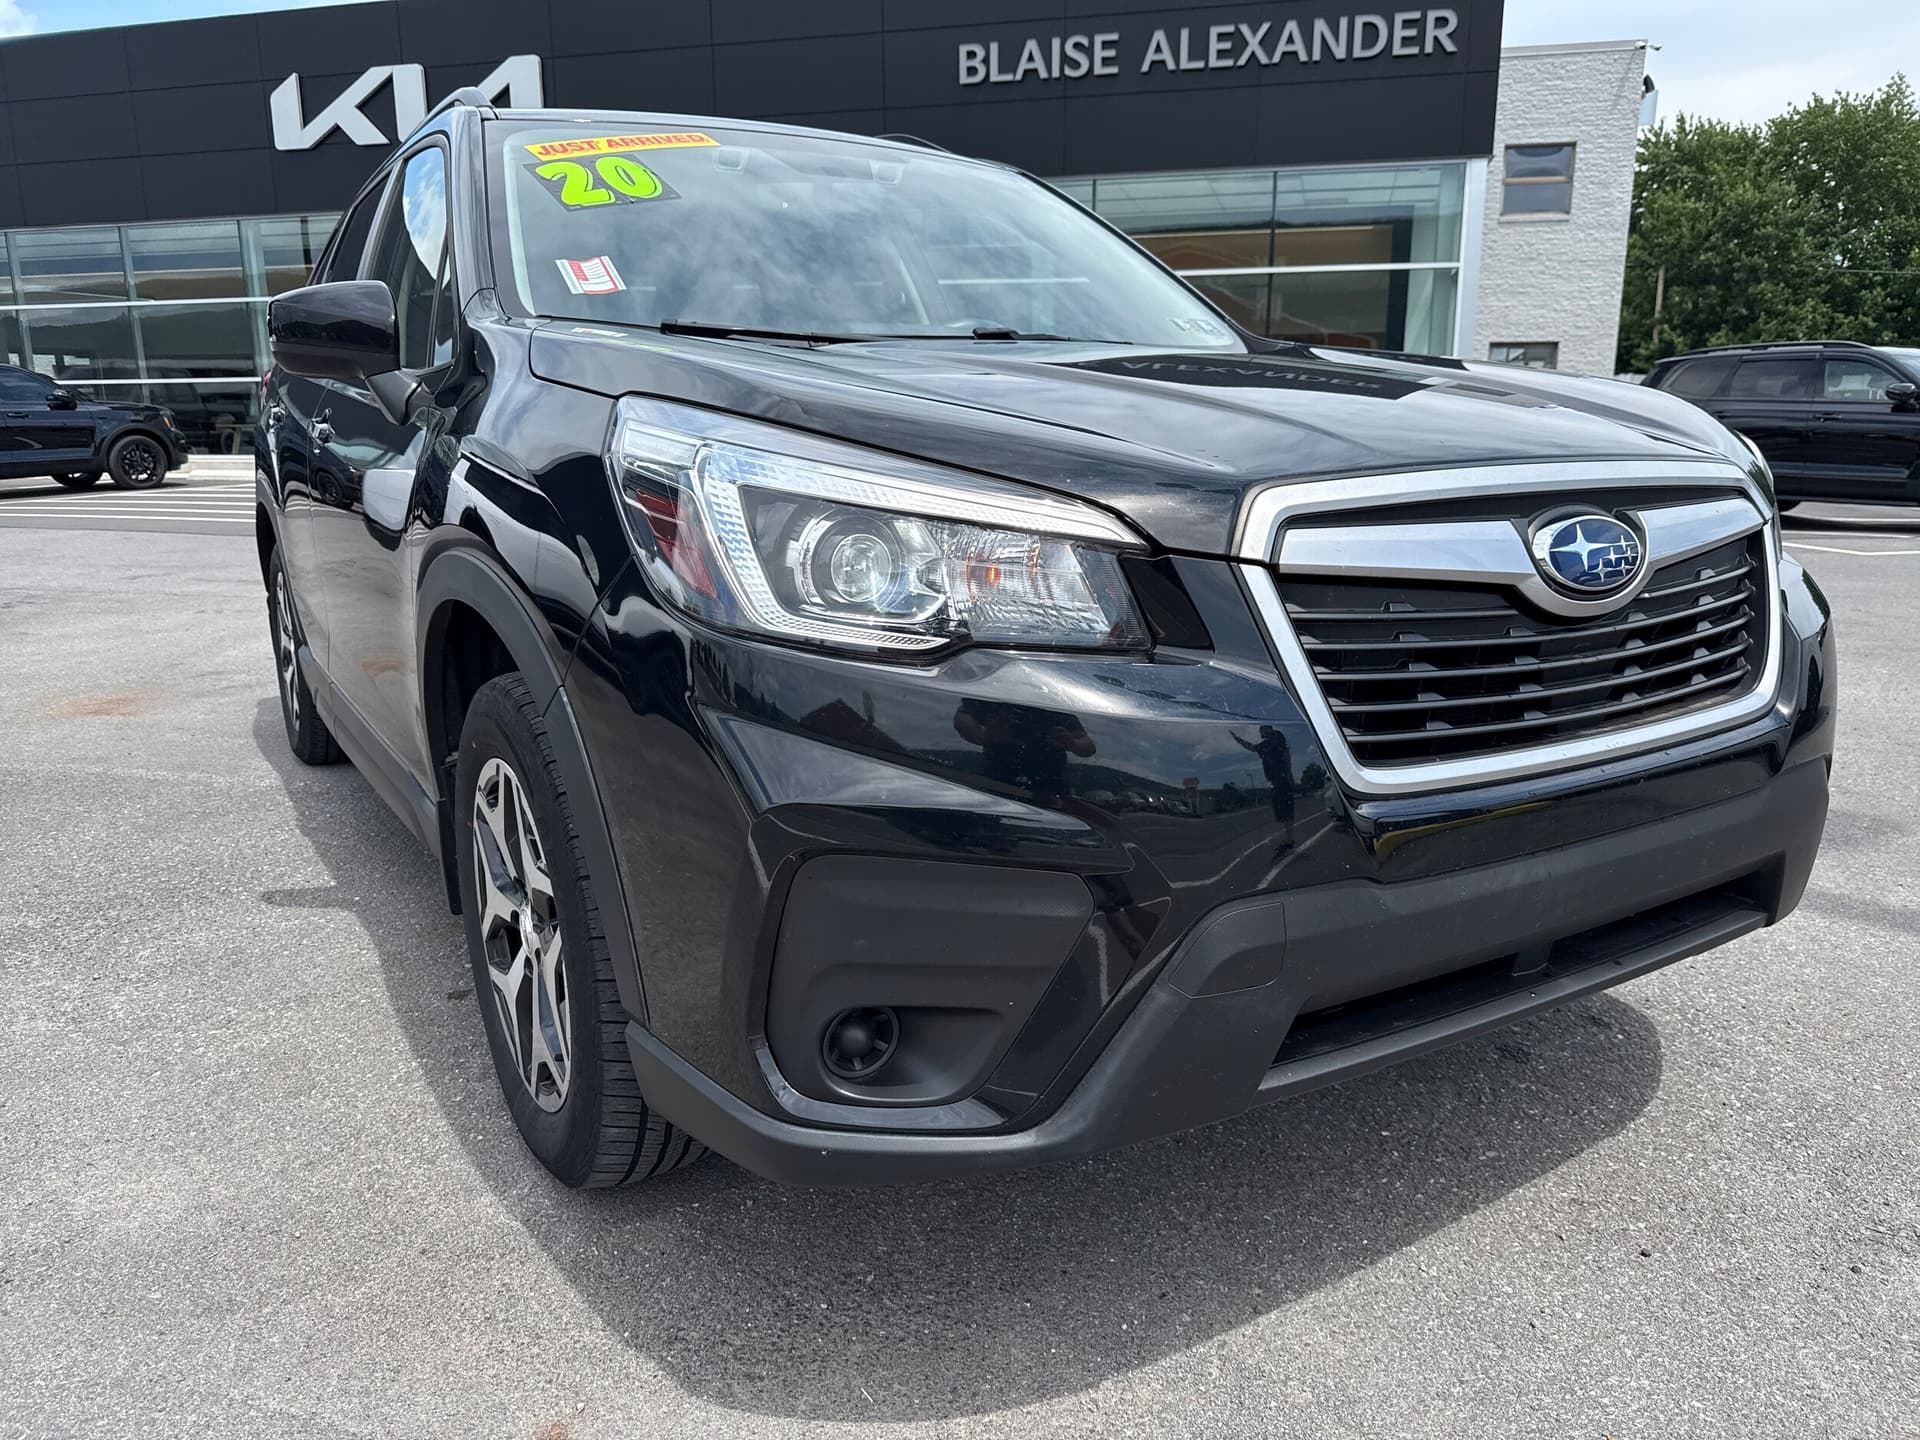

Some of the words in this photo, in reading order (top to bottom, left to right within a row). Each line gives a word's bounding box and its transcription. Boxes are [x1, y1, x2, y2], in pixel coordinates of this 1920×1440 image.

[957, 32, 1120, 85] BLAISE
[1140, 8, 1459, 75] ALEXANDER
[538, 140, 600, 157] JUST
[606, 134, 709, 149] ARRIVED
[535, 156, 663, 206] 20
